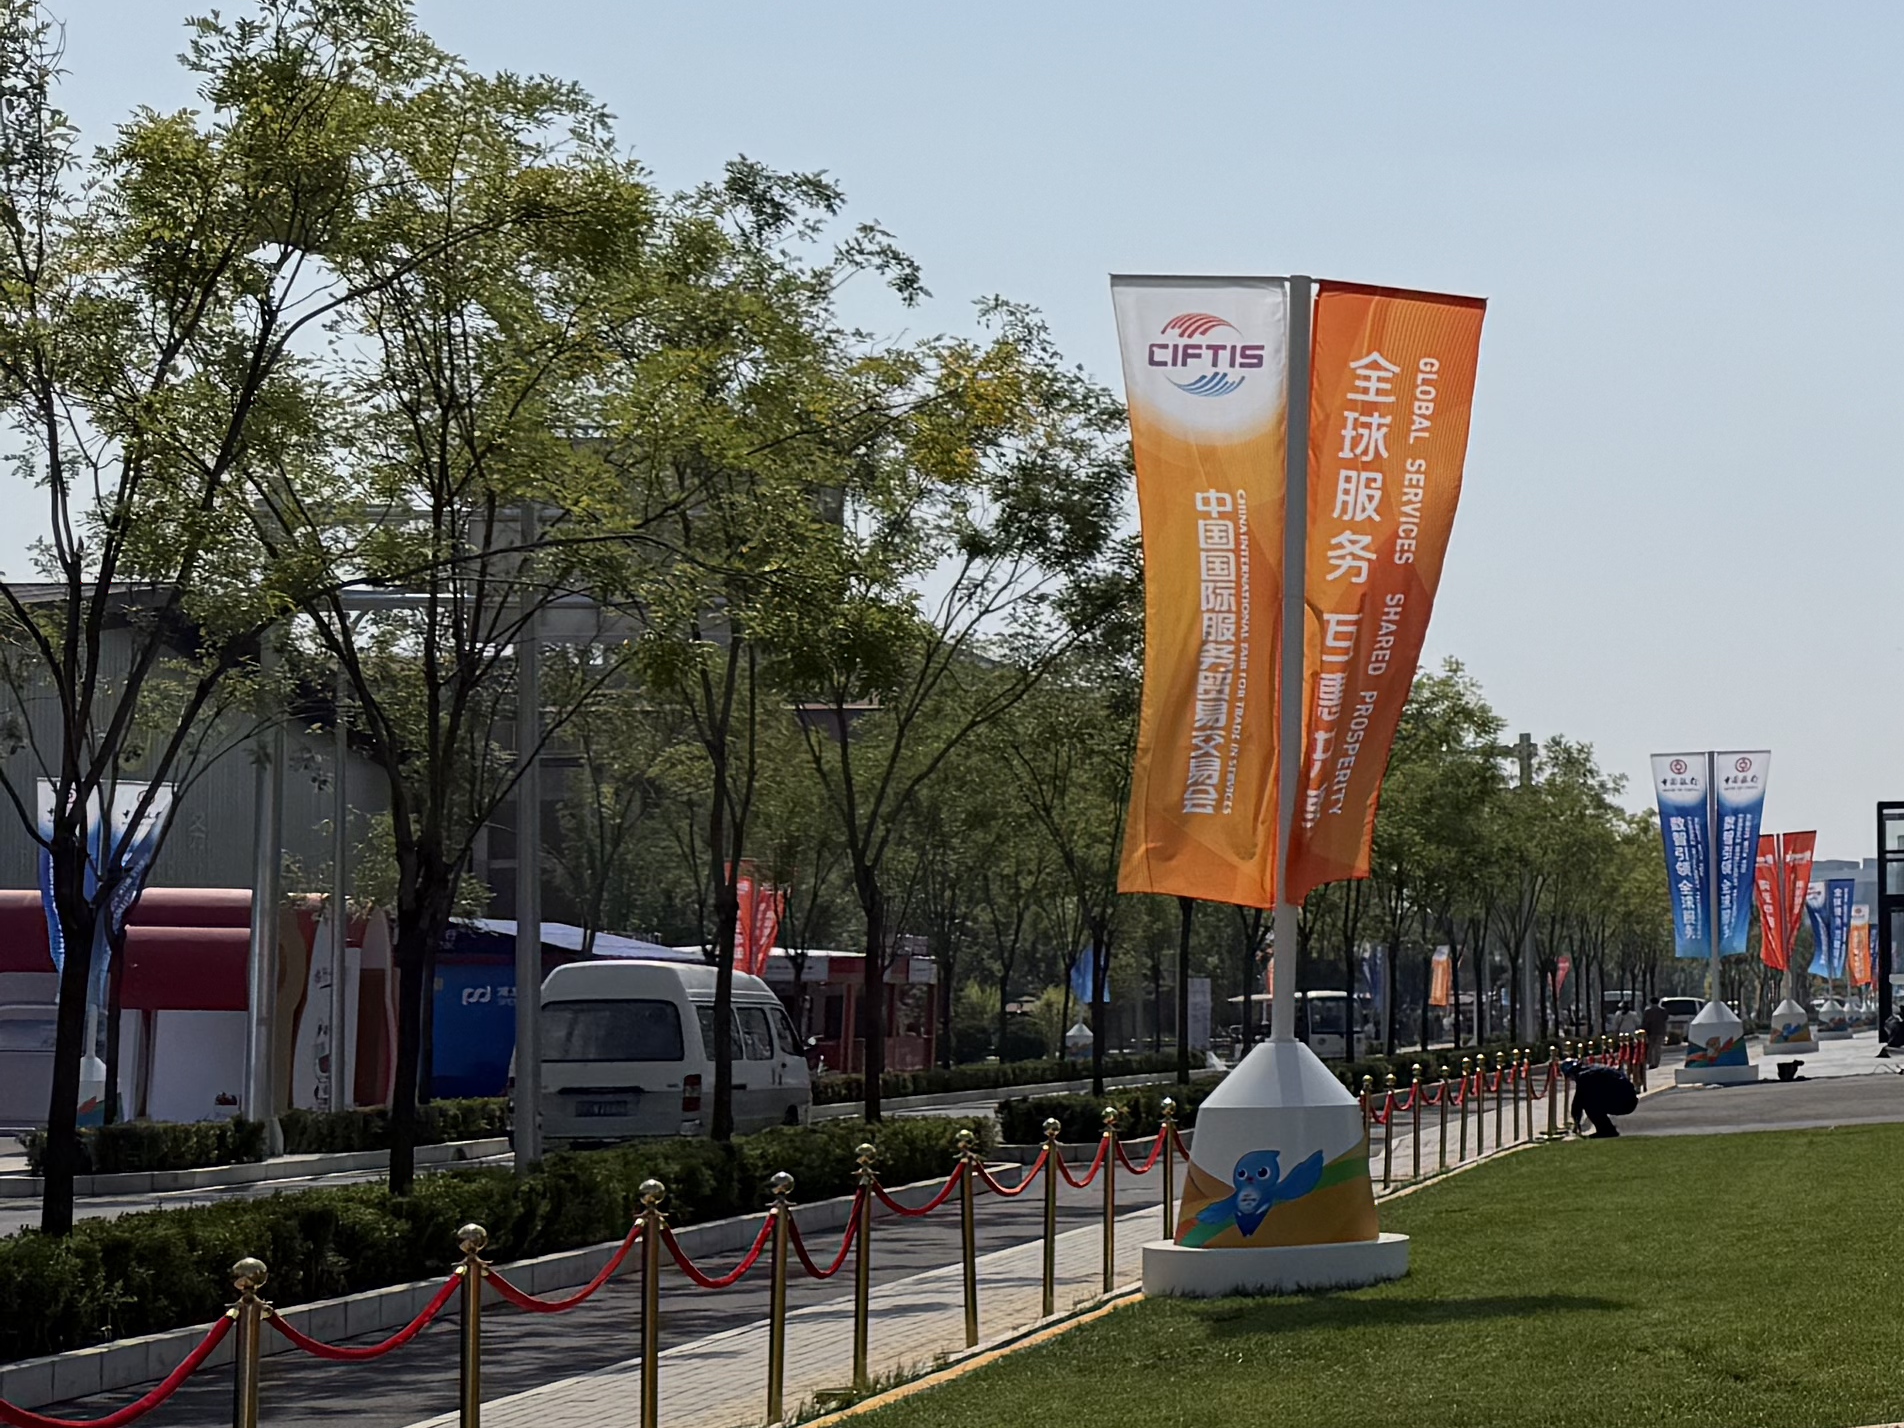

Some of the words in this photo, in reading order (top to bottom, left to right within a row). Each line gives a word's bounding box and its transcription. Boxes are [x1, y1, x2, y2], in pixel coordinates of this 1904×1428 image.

[1148, 343, 1265, 368] CIFTIS
[1409, 357, 1440, 444] GLOBAL
[1326, 351, 1400, 584] 全球服务
[1237, 489, 1248, 533] CHINA
[1394, 458, 1426, 565] SERVICES
[1239, 534, 1250, 639] INTERNATIONAL
[1183, 488, 1236, 814] 中国国际服务贸易交易会
[1240, 642, 1249, 670] FAIR
[1368, 593, 1404, 676] SHARED
[1230, 743, 1240, 757] IN
[1231, 701, 1245, 740] TRADE
[1328, 690, 1378, 814] PROSPERITY
[1222, 759, 1237, 815] SERVICES
